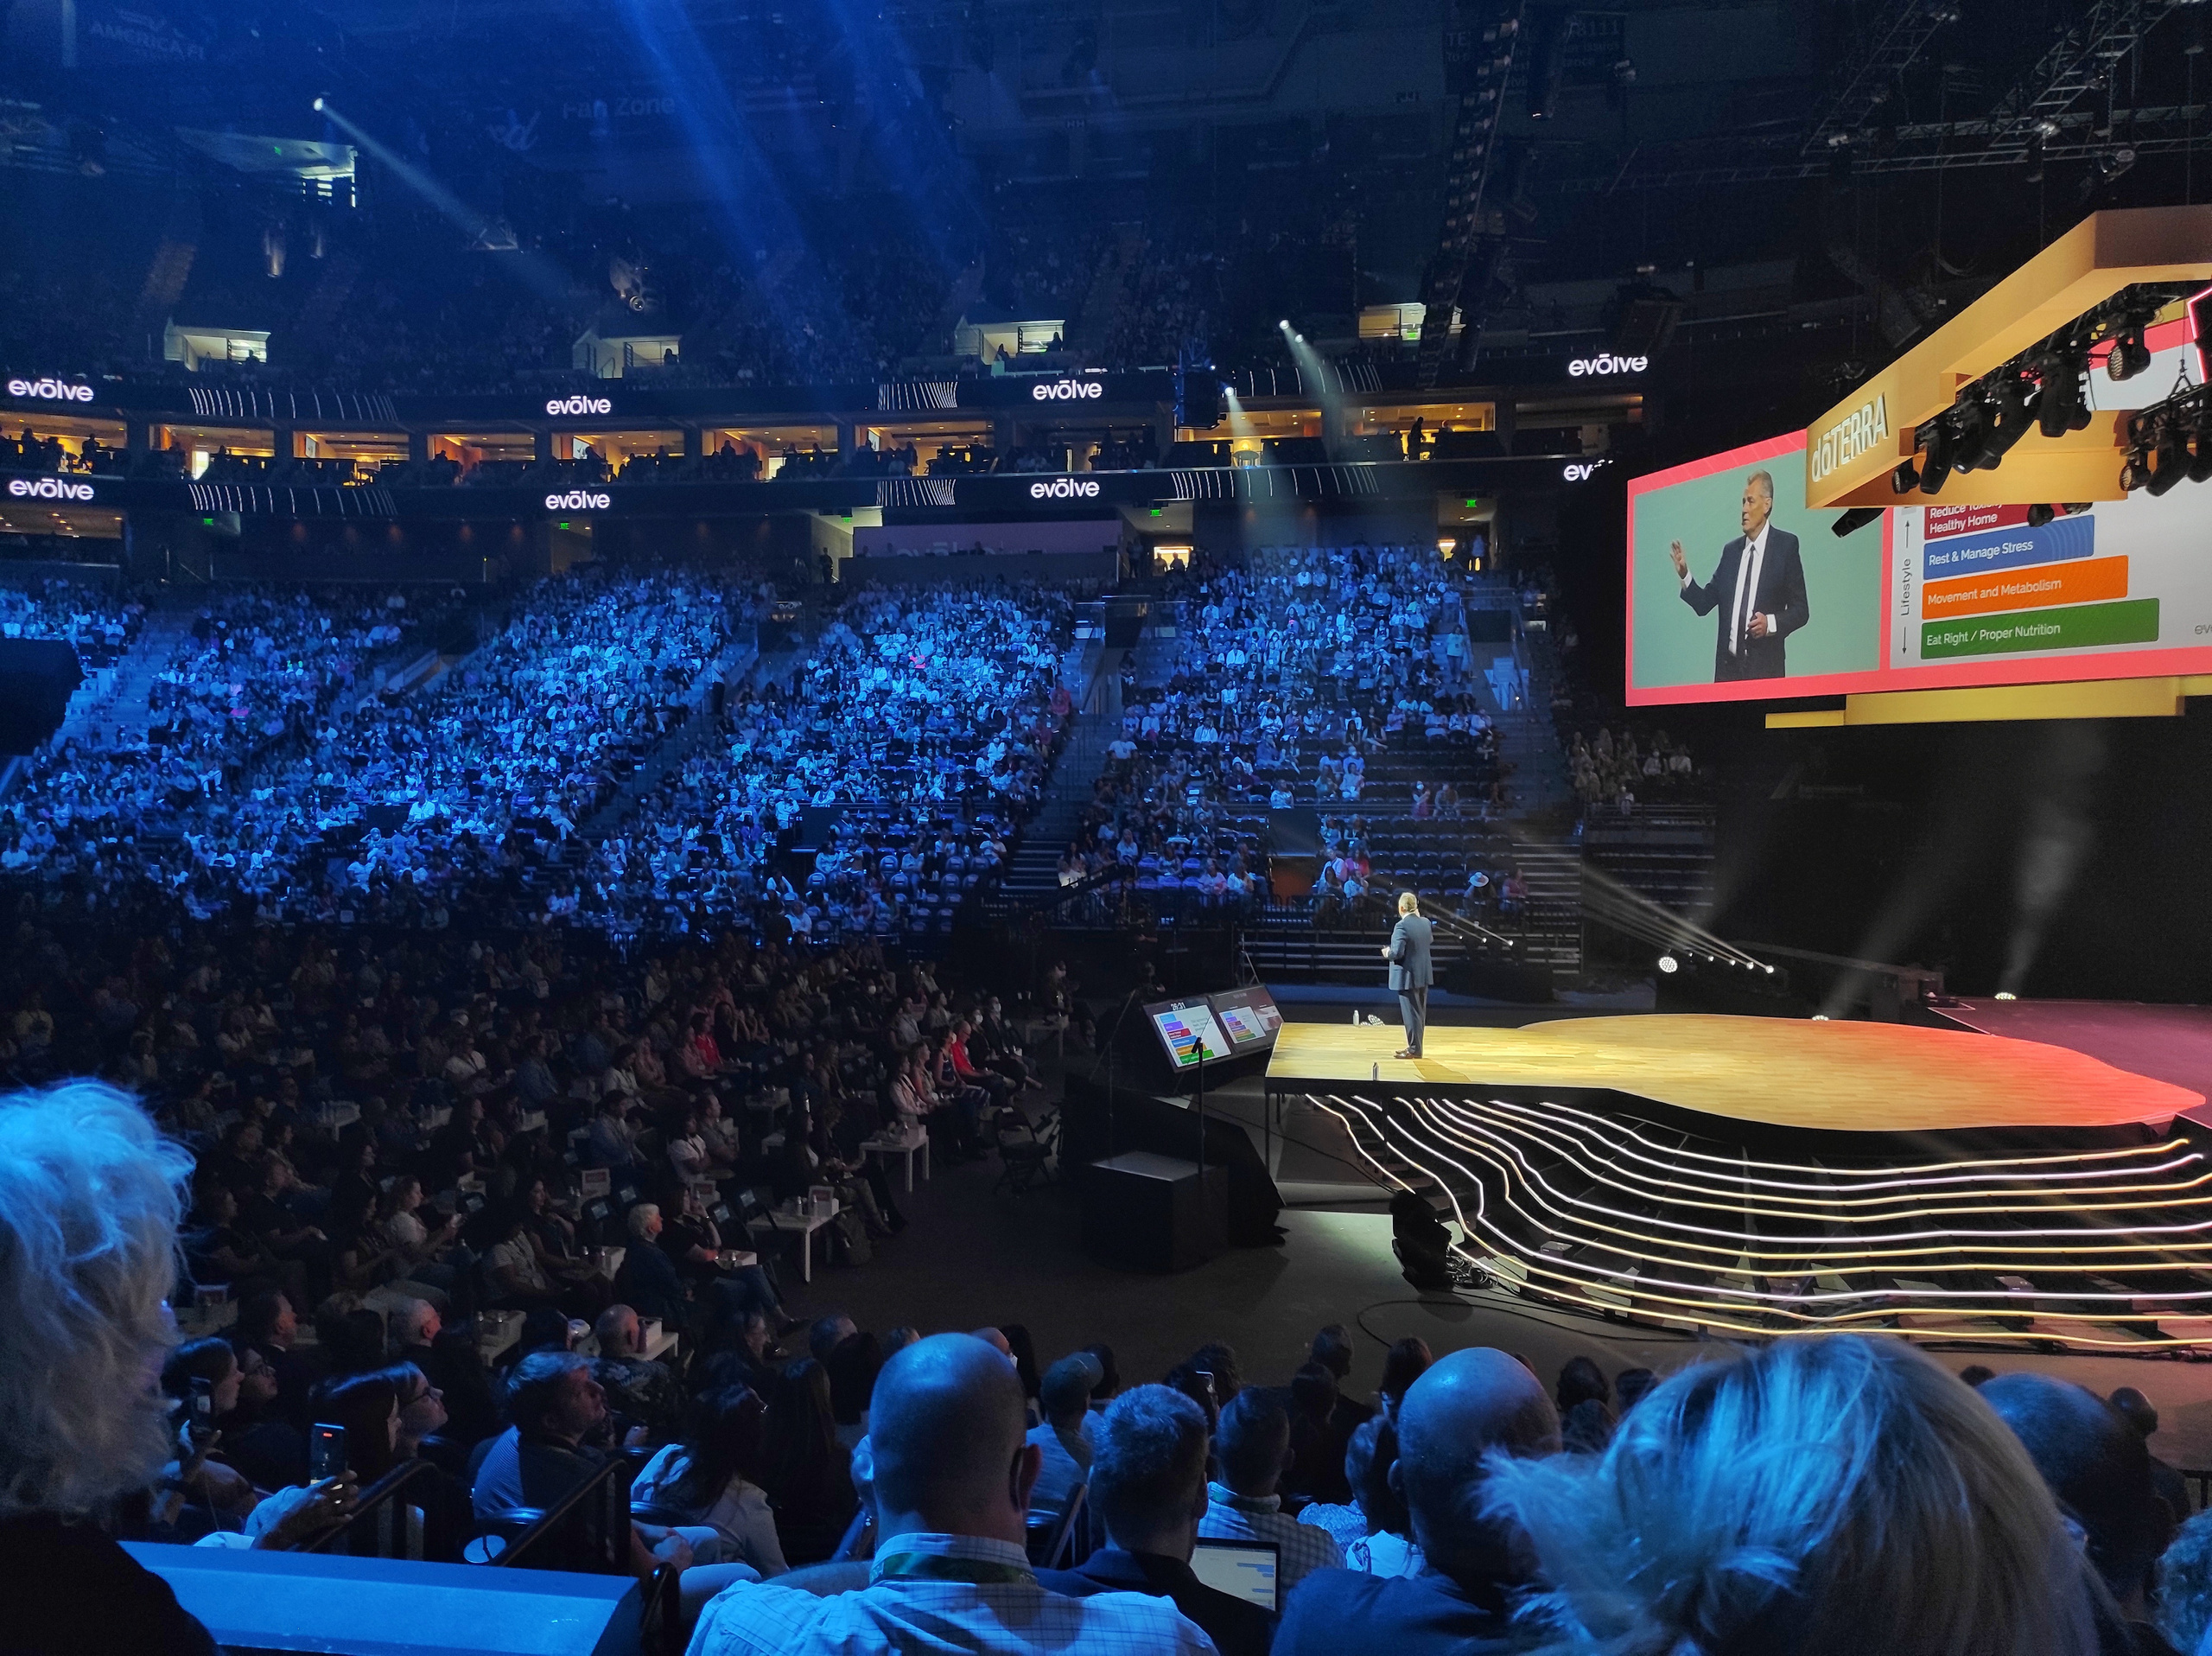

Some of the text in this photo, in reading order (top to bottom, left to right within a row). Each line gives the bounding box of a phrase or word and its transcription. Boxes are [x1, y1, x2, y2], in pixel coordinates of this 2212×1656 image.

[1568, 353, 1649, 377] evōlve
[9, 379, 94, 402] evōlve
[1033, 379, 1103, 400] evōlve
[546, 395, 612, 415] evōlve
[9, 478, 94, 500] evōlve
[1030, 478, 1100, 499] evōlve
[545, 490, 611, 509] evōlve
[1929, 505, 1967, 519] Reduce
[1929, 513, 1998, 534] Healthy Home
[1929, 539, 2034, 566] Rest & Manage Stress
[1901, 558, 1912, 616] Lifestyle
[1928, 578, 2063, 605] Movement and Metabolism
[1926, 623, 2061, 646] Eat Right / Proper Nutrition
[2195, 624, 2212, 635] ev
